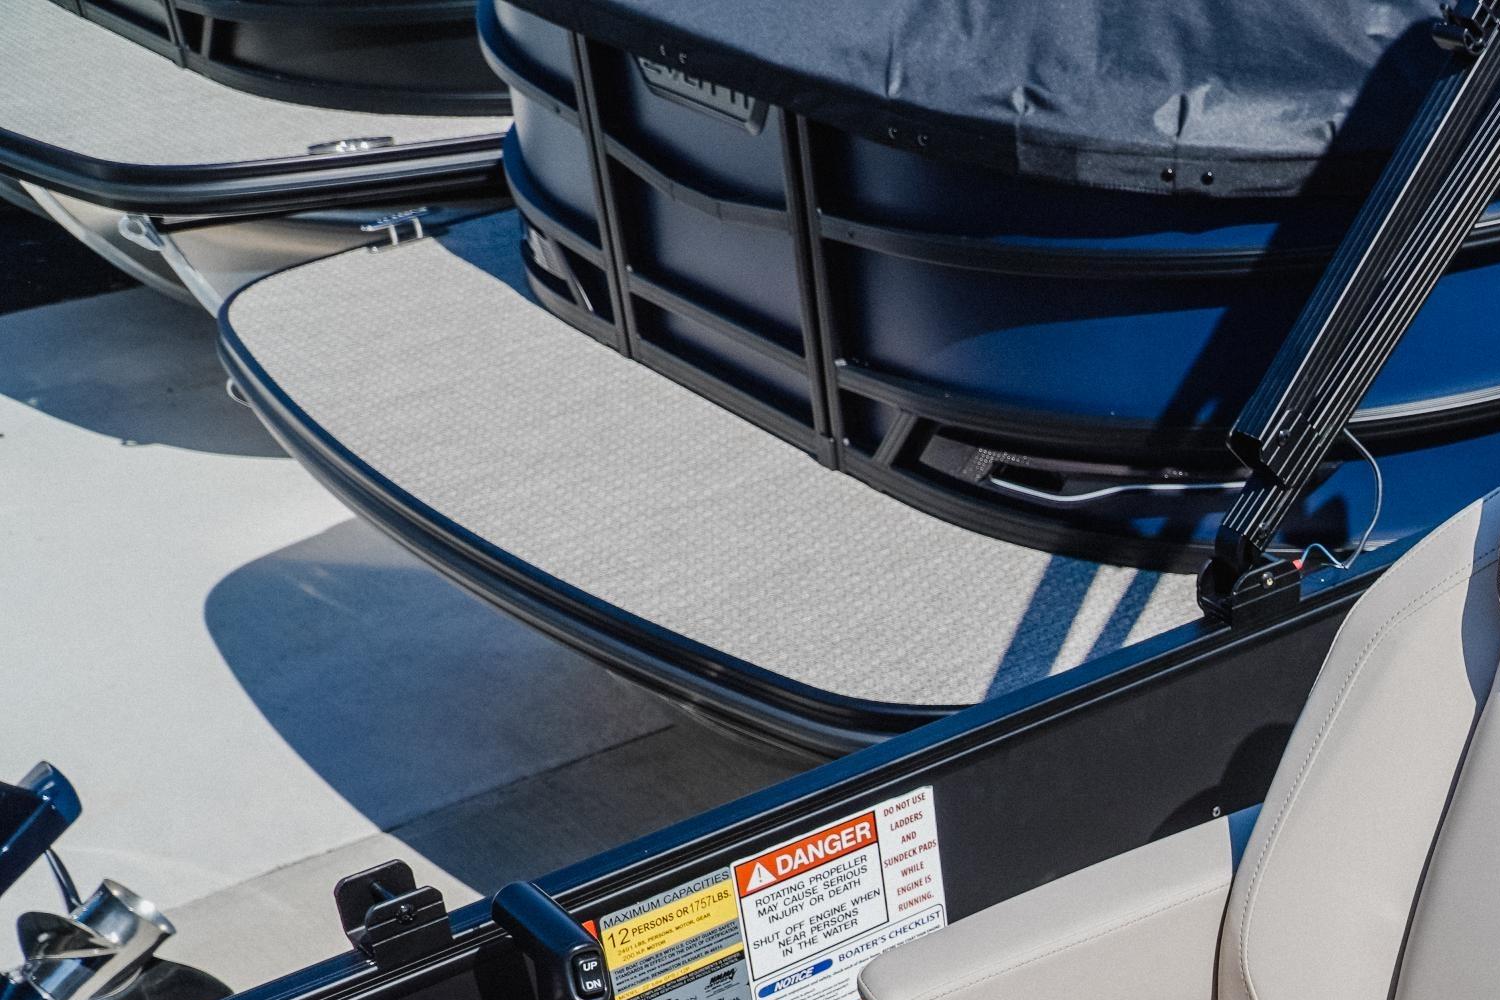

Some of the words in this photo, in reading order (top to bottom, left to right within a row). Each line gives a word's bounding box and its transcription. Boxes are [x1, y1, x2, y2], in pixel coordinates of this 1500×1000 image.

[884, 806, 894, 817] DO
[896, 799, 911, 812] NOT
[912, 792, 926, 805] USE
[890, 811, 923, 831] LADDERS
[775, 820, 871, 876] DANGER
[884, 847, 917, 868] SUNDECK
[918, 840, 936, 854] PADS
[901, 831, 917, 844] AND
[754, 880, 804, 908] ROTATING
[808, 853, 867, 884] PROPELLER
[897, 878, 923, 896] ENGINE
[924, 874, 932, 884] IS
[901, 861, 924, 878] WHILE
[603, 899, 660, 928] MAXIMUM
[662, 870, 729, 904] CAPACITIES
[757, 902, 779, 917] MAY
[783, 885, 817, 906] CAUSE
[822, 864, 867, 889] SERIOUS
[768, 902, 804, 924] INJURY
[809, 893, 824, 906] OR
[828, 877, 860, 898] DEATH
[898, 891, 934, 912] RUNNING.
[607, 926, 630, 949] 12
[631, 912, 674, 936] PERSONS
[676, 906, 689, 918] OR
[689, 895, 712, 913] 1757
[711, 888, 731, 903] LBS.
[695, 912, 710, 922] GEAR
[752, 931, 781, 950] SHUT
[785, 920, 805, 935] OFF
[809, 902, 847, 924] ENGINE
[850, 887, 880, 906] WHEN
[778, 930, 806, 948] NEAR
[810, 907, 858, 934] PERSONS
[782, 946, 792, 957] IN
[798, 935, 818, 950] THE
[822, 917, 857, 939] WATER
[615, 965, 643, 980] STANDARDS
[649, 955, 666, 965] EFFECT
[704, 925, 738, 942] CERTIFICATION
[639, 952, 662, 964] COMPLIES
[685, 936, 700, 945] COAST
[701, 928, 717, 938] GUARD
[718, 921, 734, 931] SAFETY
[646, 939, 665, 950] MOTOR
[773, 966, 814, 991] NOTICE
[838, 934, 886, 962] BOATER'S
[888, 910, 940, 939] CHECKLIST
[583, 961, 598, 971] UP
[586, 979, 602, 990] DN
